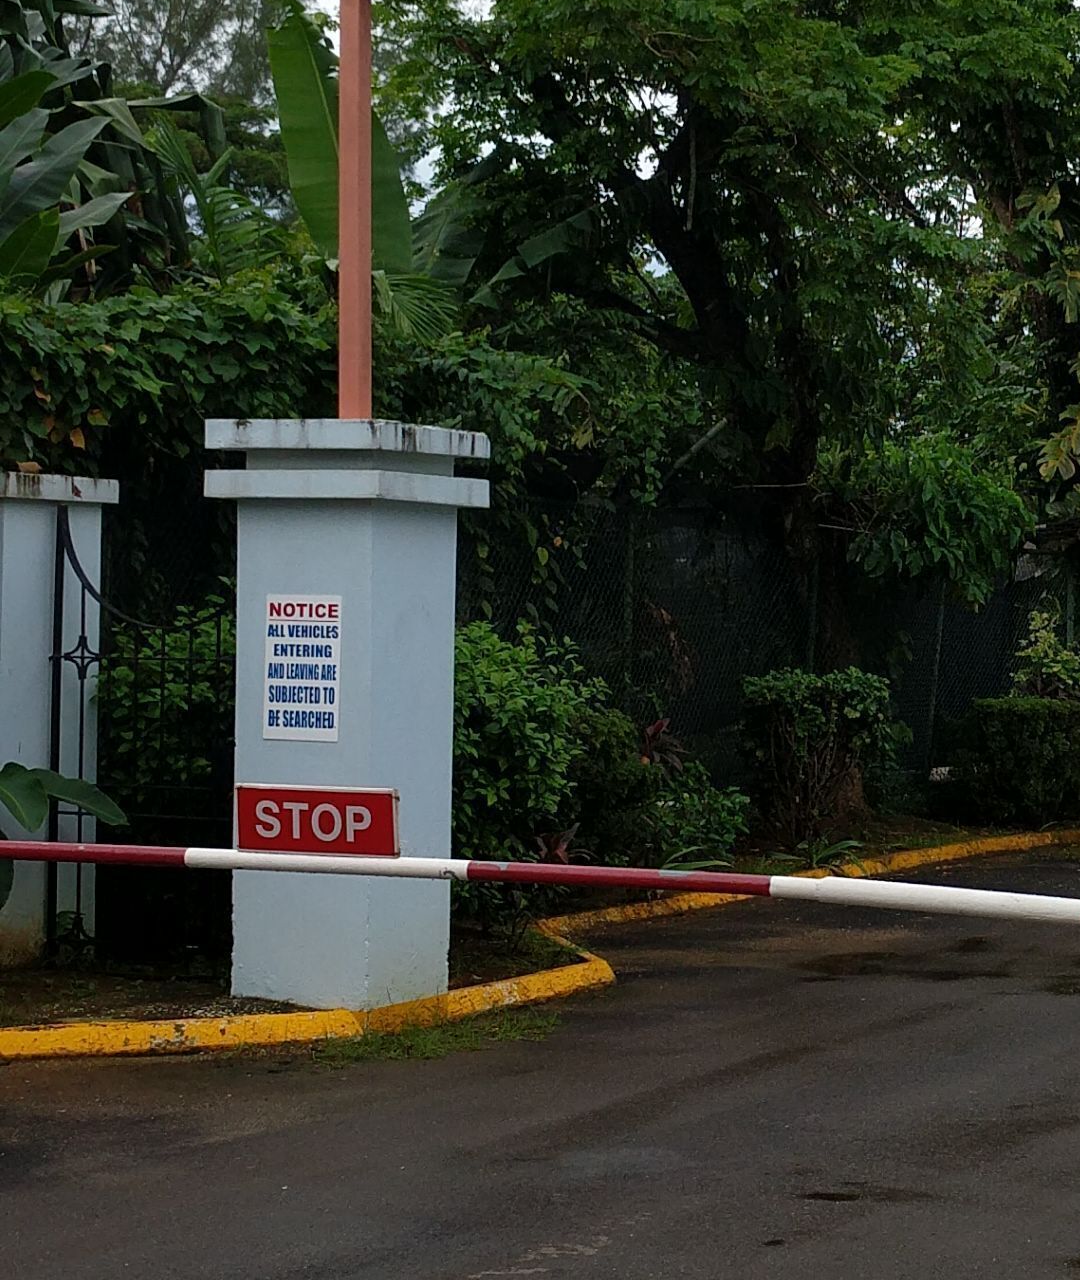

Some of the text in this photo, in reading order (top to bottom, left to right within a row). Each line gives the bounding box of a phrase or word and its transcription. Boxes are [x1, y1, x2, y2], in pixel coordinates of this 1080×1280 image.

[269, 603, 339, 618] NOTICE
[268, 624, 338, 639] ALL VEHICLES
[274, 644, 332, 658] ENTERING
[268, 663, 336, 681] AND LEAVING ARE
[269, 685, 335, 705] SUBJECTED TO
[268, 709, 280, 727] BE
[255, 800, 371, 843] STOP
